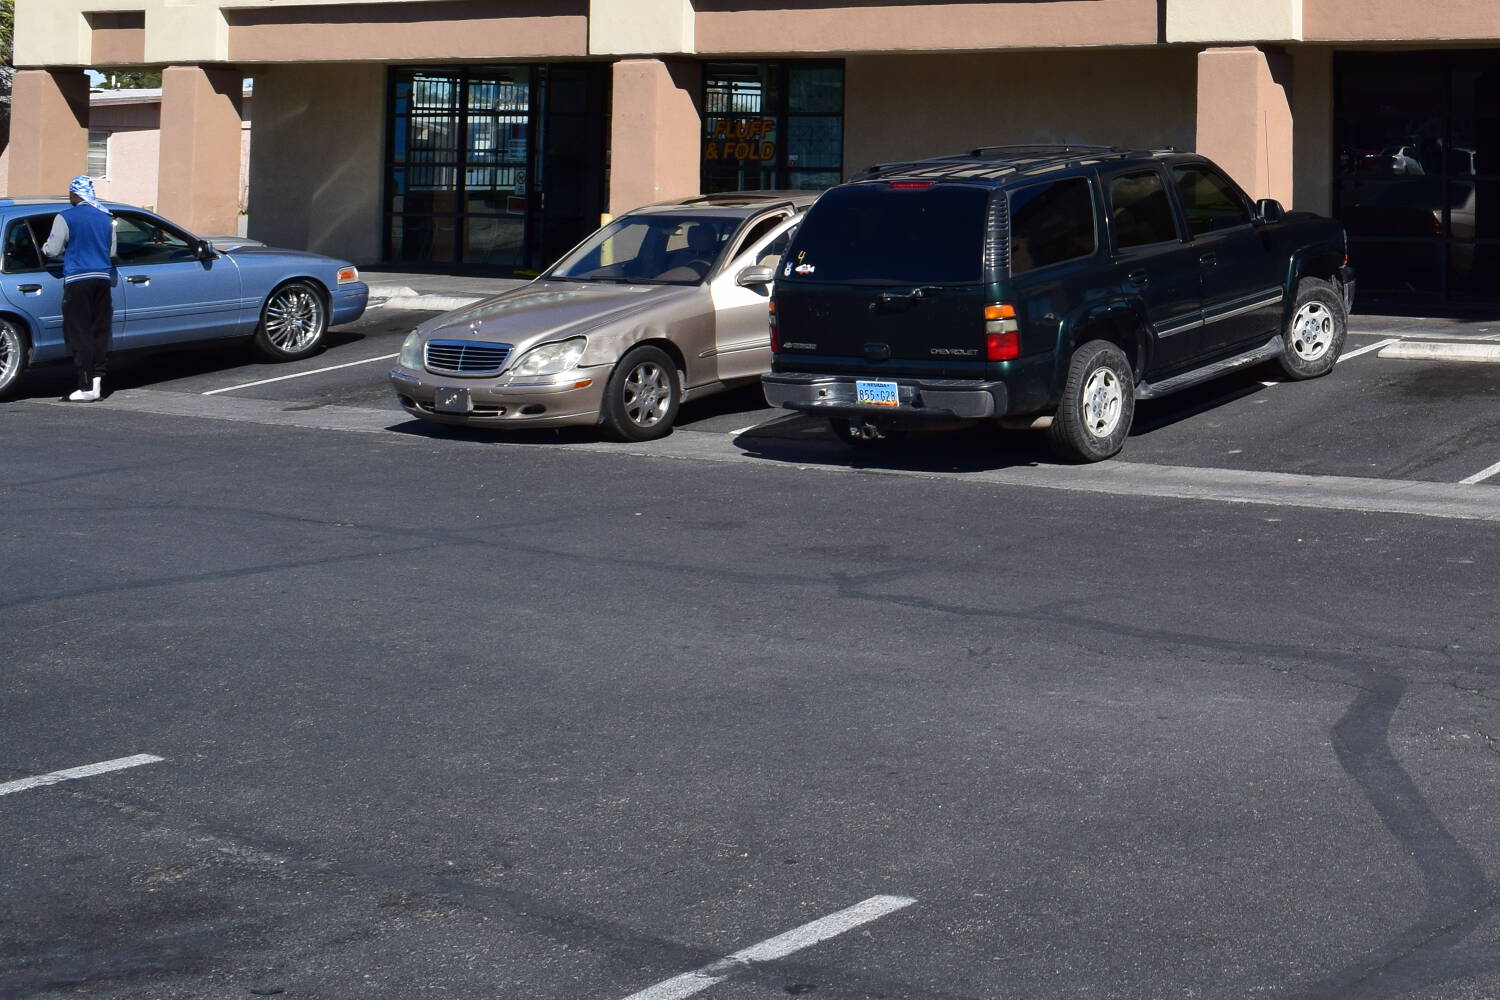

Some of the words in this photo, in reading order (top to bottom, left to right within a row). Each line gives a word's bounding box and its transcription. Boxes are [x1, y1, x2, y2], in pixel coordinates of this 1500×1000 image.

[714, 119, 775, 139] FLUFF
[704, 141, 720, 160] &
[722, 141, 776, 160] FOLD
